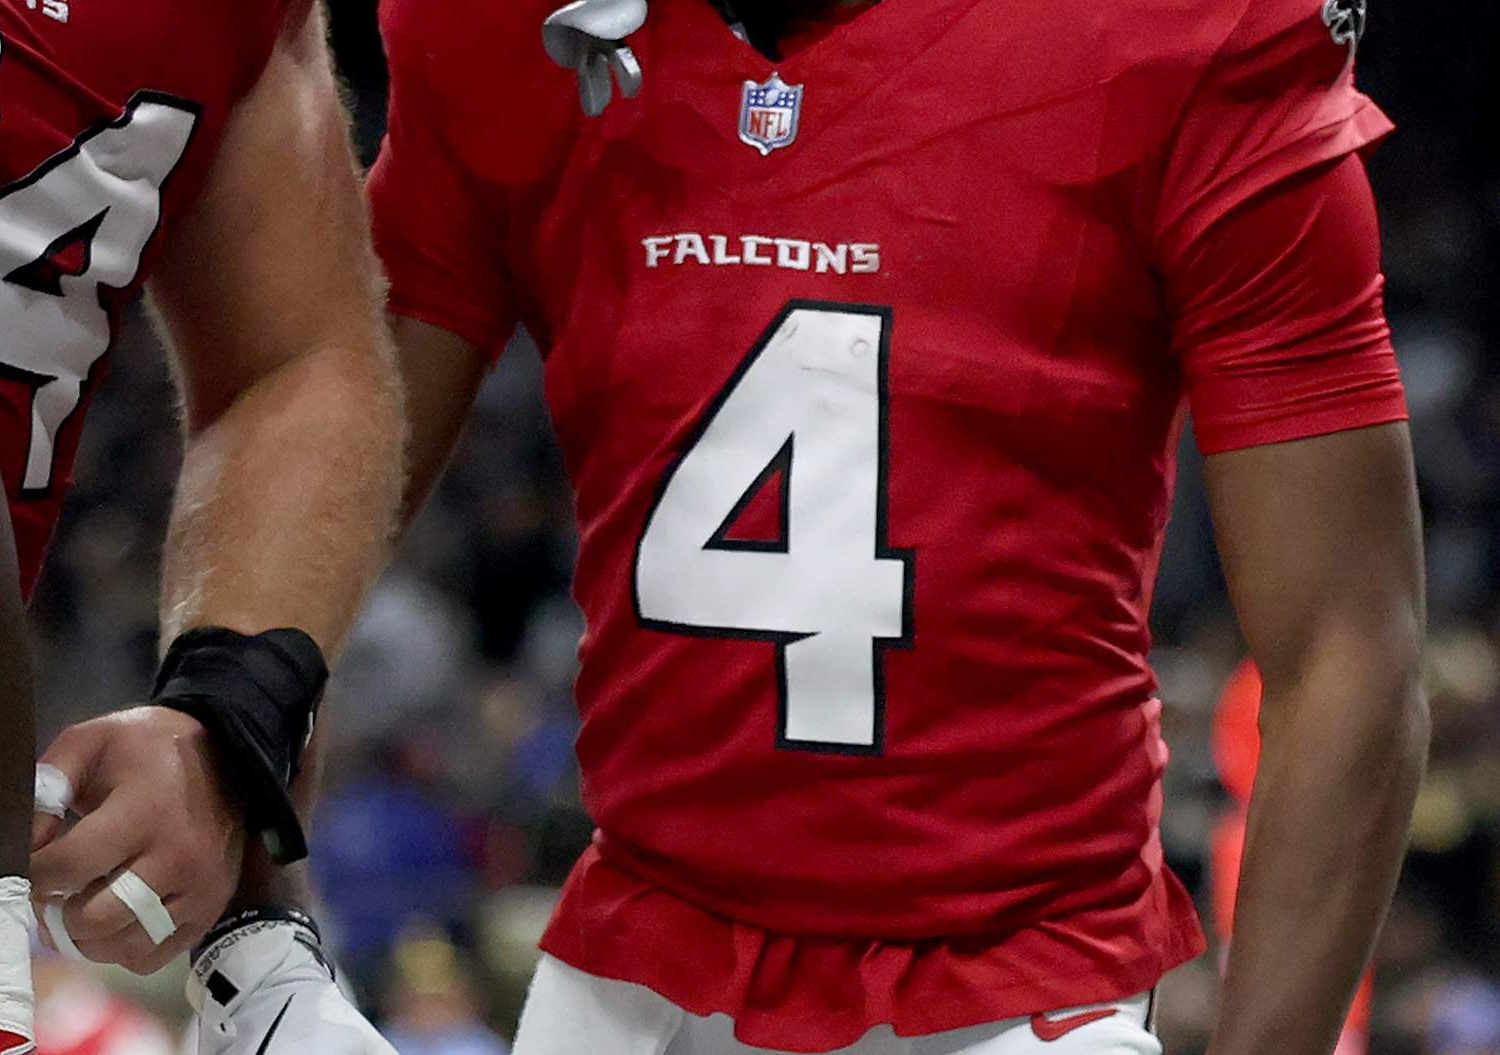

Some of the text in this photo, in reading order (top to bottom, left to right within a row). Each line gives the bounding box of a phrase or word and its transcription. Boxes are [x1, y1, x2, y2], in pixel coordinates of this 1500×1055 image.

[748, 111, 788, 138] NFL
[641, 233, 880, 274] FALCONS
[632, 298, 916, 757] 4
